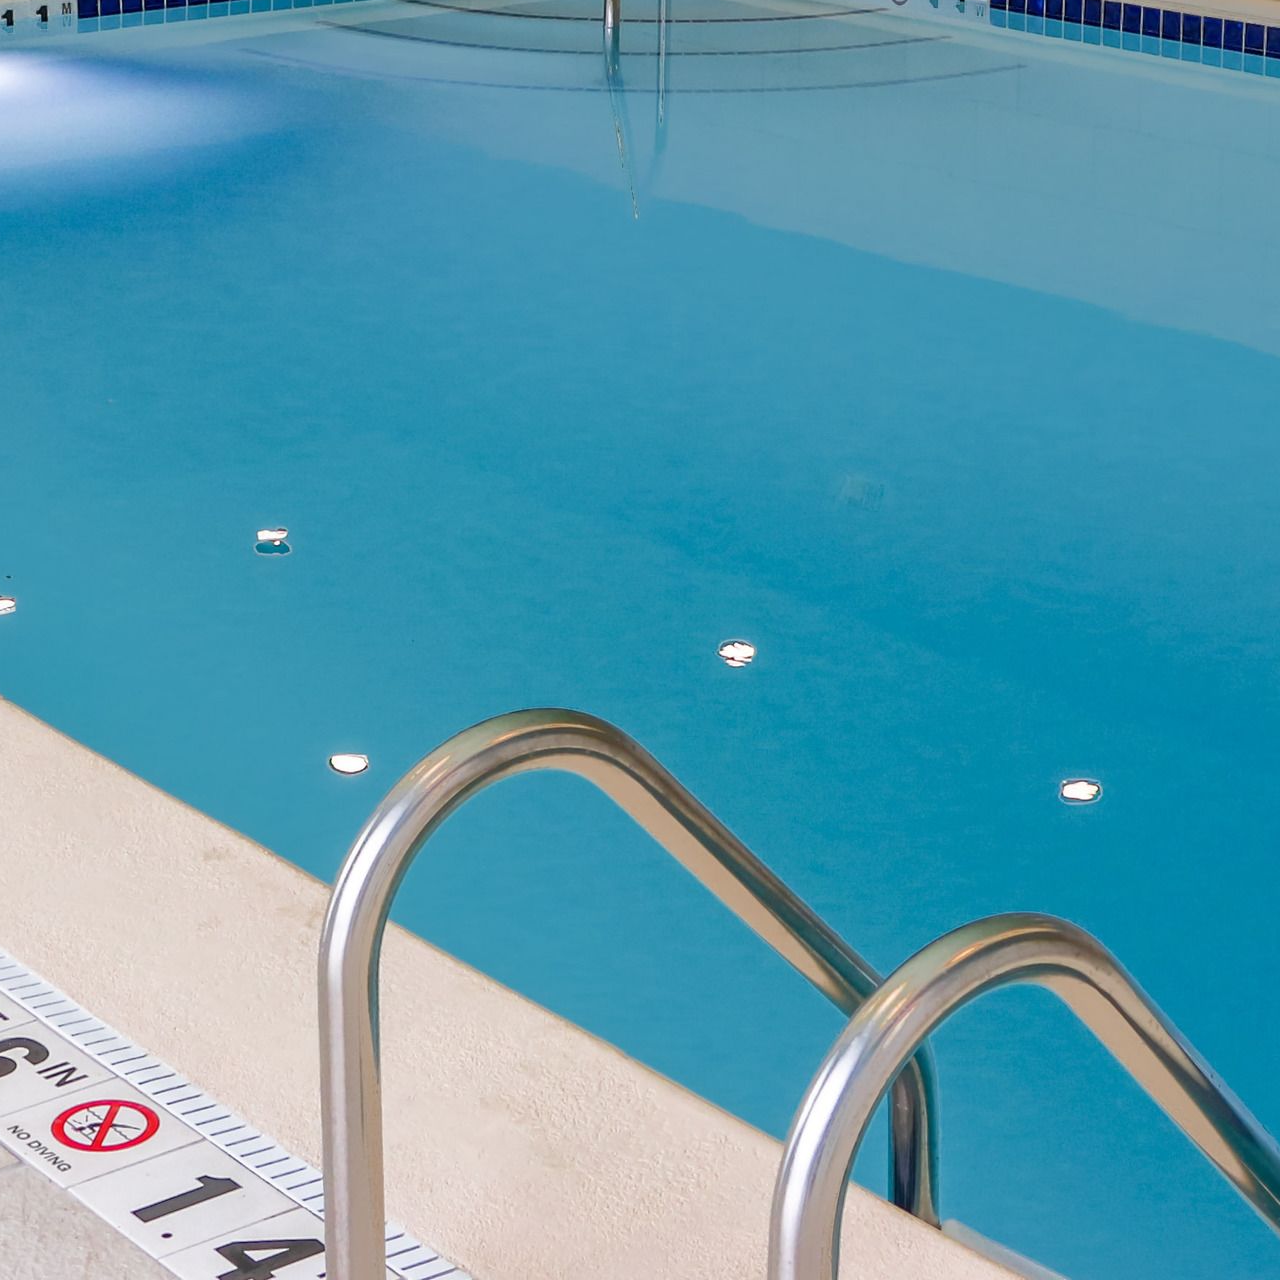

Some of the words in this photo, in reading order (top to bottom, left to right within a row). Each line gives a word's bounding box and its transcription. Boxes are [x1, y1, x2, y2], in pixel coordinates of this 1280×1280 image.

[61, 2, 72, 15] M
[35, 1060, 88, 1089] IN
[7, 1124, 31, 1140] NO
[26, 1140, 72, 1172] DIVING
